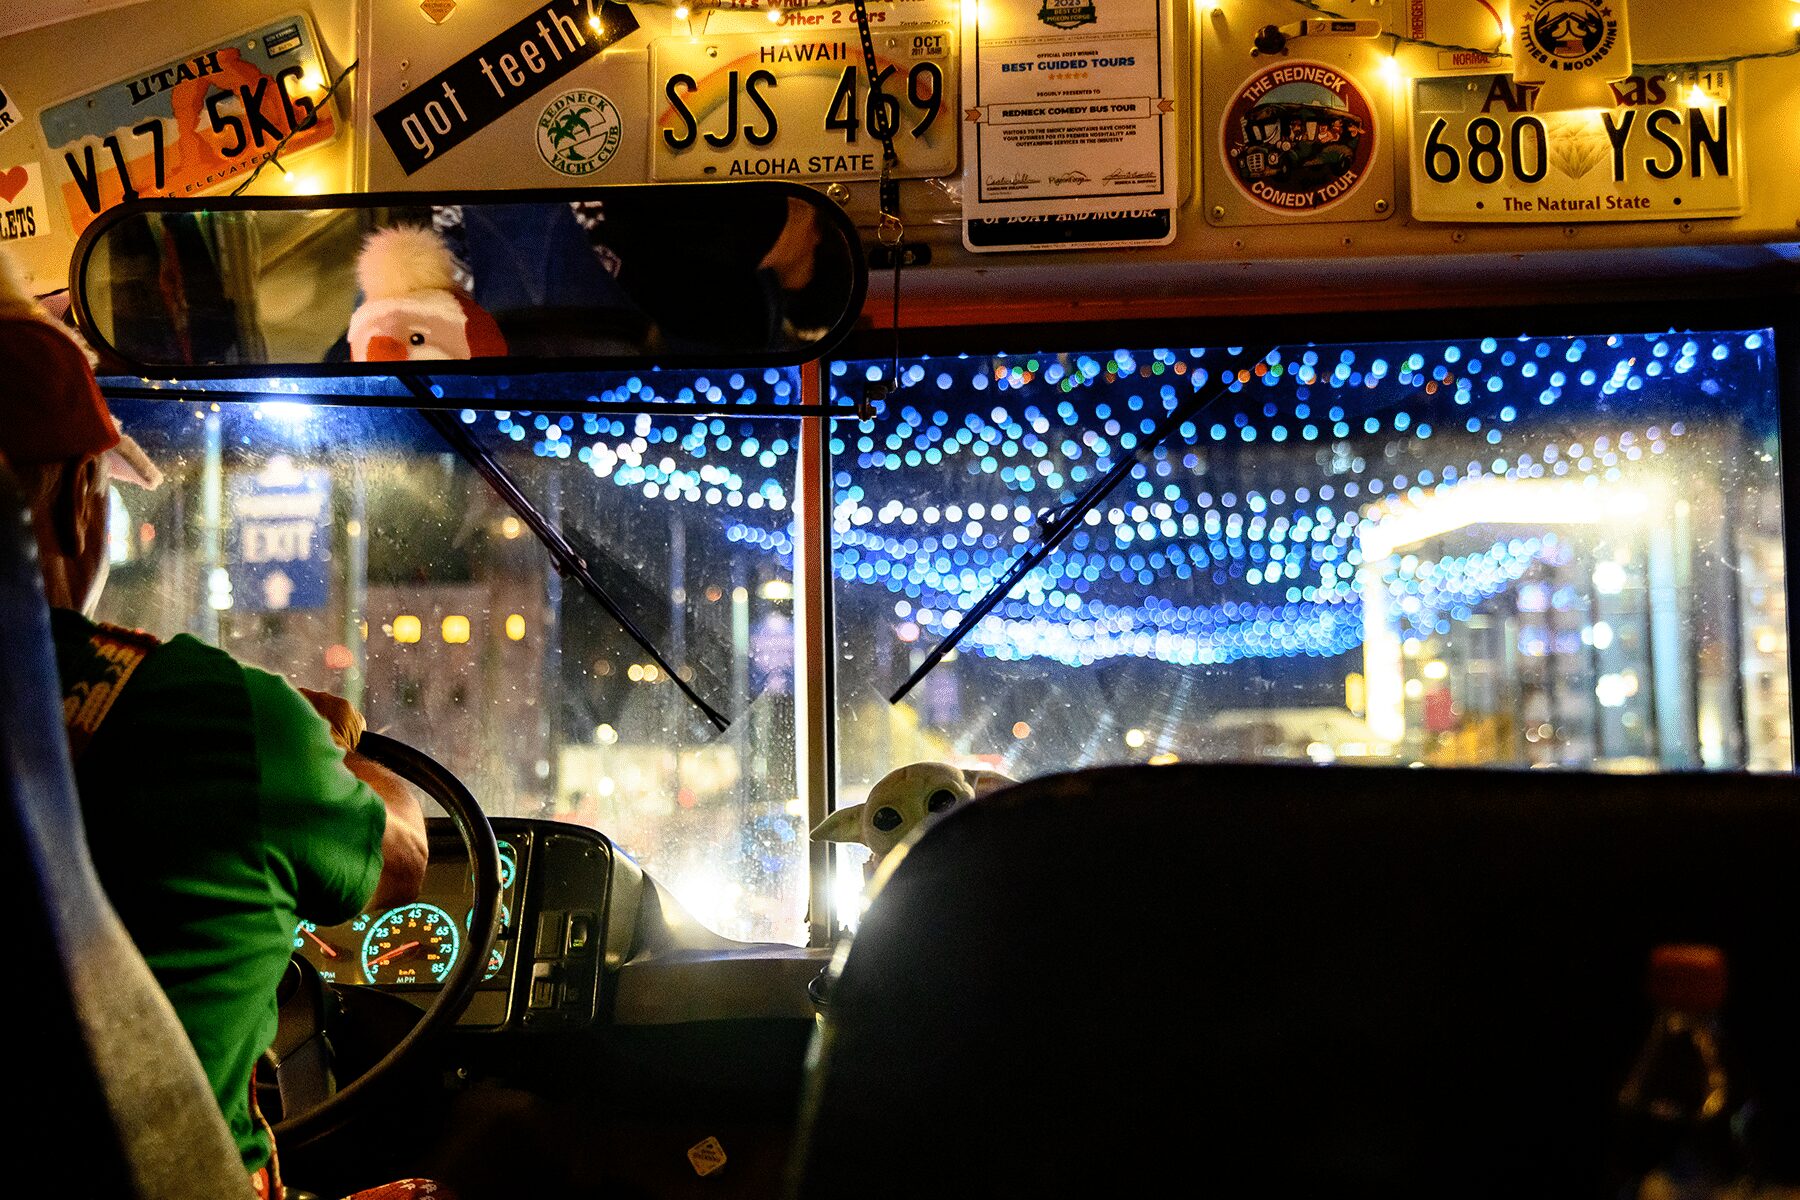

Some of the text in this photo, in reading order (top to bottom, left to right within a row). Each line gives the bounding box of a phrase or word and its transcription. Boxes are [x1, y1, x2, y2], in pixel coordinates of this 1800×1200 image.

[831, 10, 842, 24] 2
[913, 35, 943, 48] OCT
[1563, 20, 1617, 71] MOONSHINE
[760, 42, 846, 64] HAWAII
[1001, 57, 1136, 73] BEST GUIDED TOURS
[127, 51, 223, 106] UTAH
[1242, 66, 1347, 102] THE REDNECK
[205, 65, 319, 158] 5KG
[541, 93, 608, 128] REDNECK
[663, 61, 943, 149] SJS 469
[1002, 108, 1046, 118] REDNECK
[1048, 106, 1088, 115] COMEDY
[1110, 104, 1136, 112] TOUR
[401, 81, 468, 159] got
[551, 126, 619, 173] YACHT CLUB
[1424, 105, 1728, 184] 680 YSN
[186, 152, 272, 192] ELEVATED
[729, 154, 874, 176] ALOHA STATE
[1251, 170, 1358, 207] COMEDY TOUR
[1503, 195, 1651, 212] The Natural State
[390, 914, 404, 924] 35
[408, 909, 422, 919] 45
[426, 914, 440, 924] 55
[352, 921, 366, 932] 30
[375, 928, 389, 938] 25
[435, 926, 449, 936] 65
[368, 945, 380, 955] 15
[439, 943, 452, 954] 75
[372, 964, 379, 974] 5
[431, 963, 445, 973] 85
